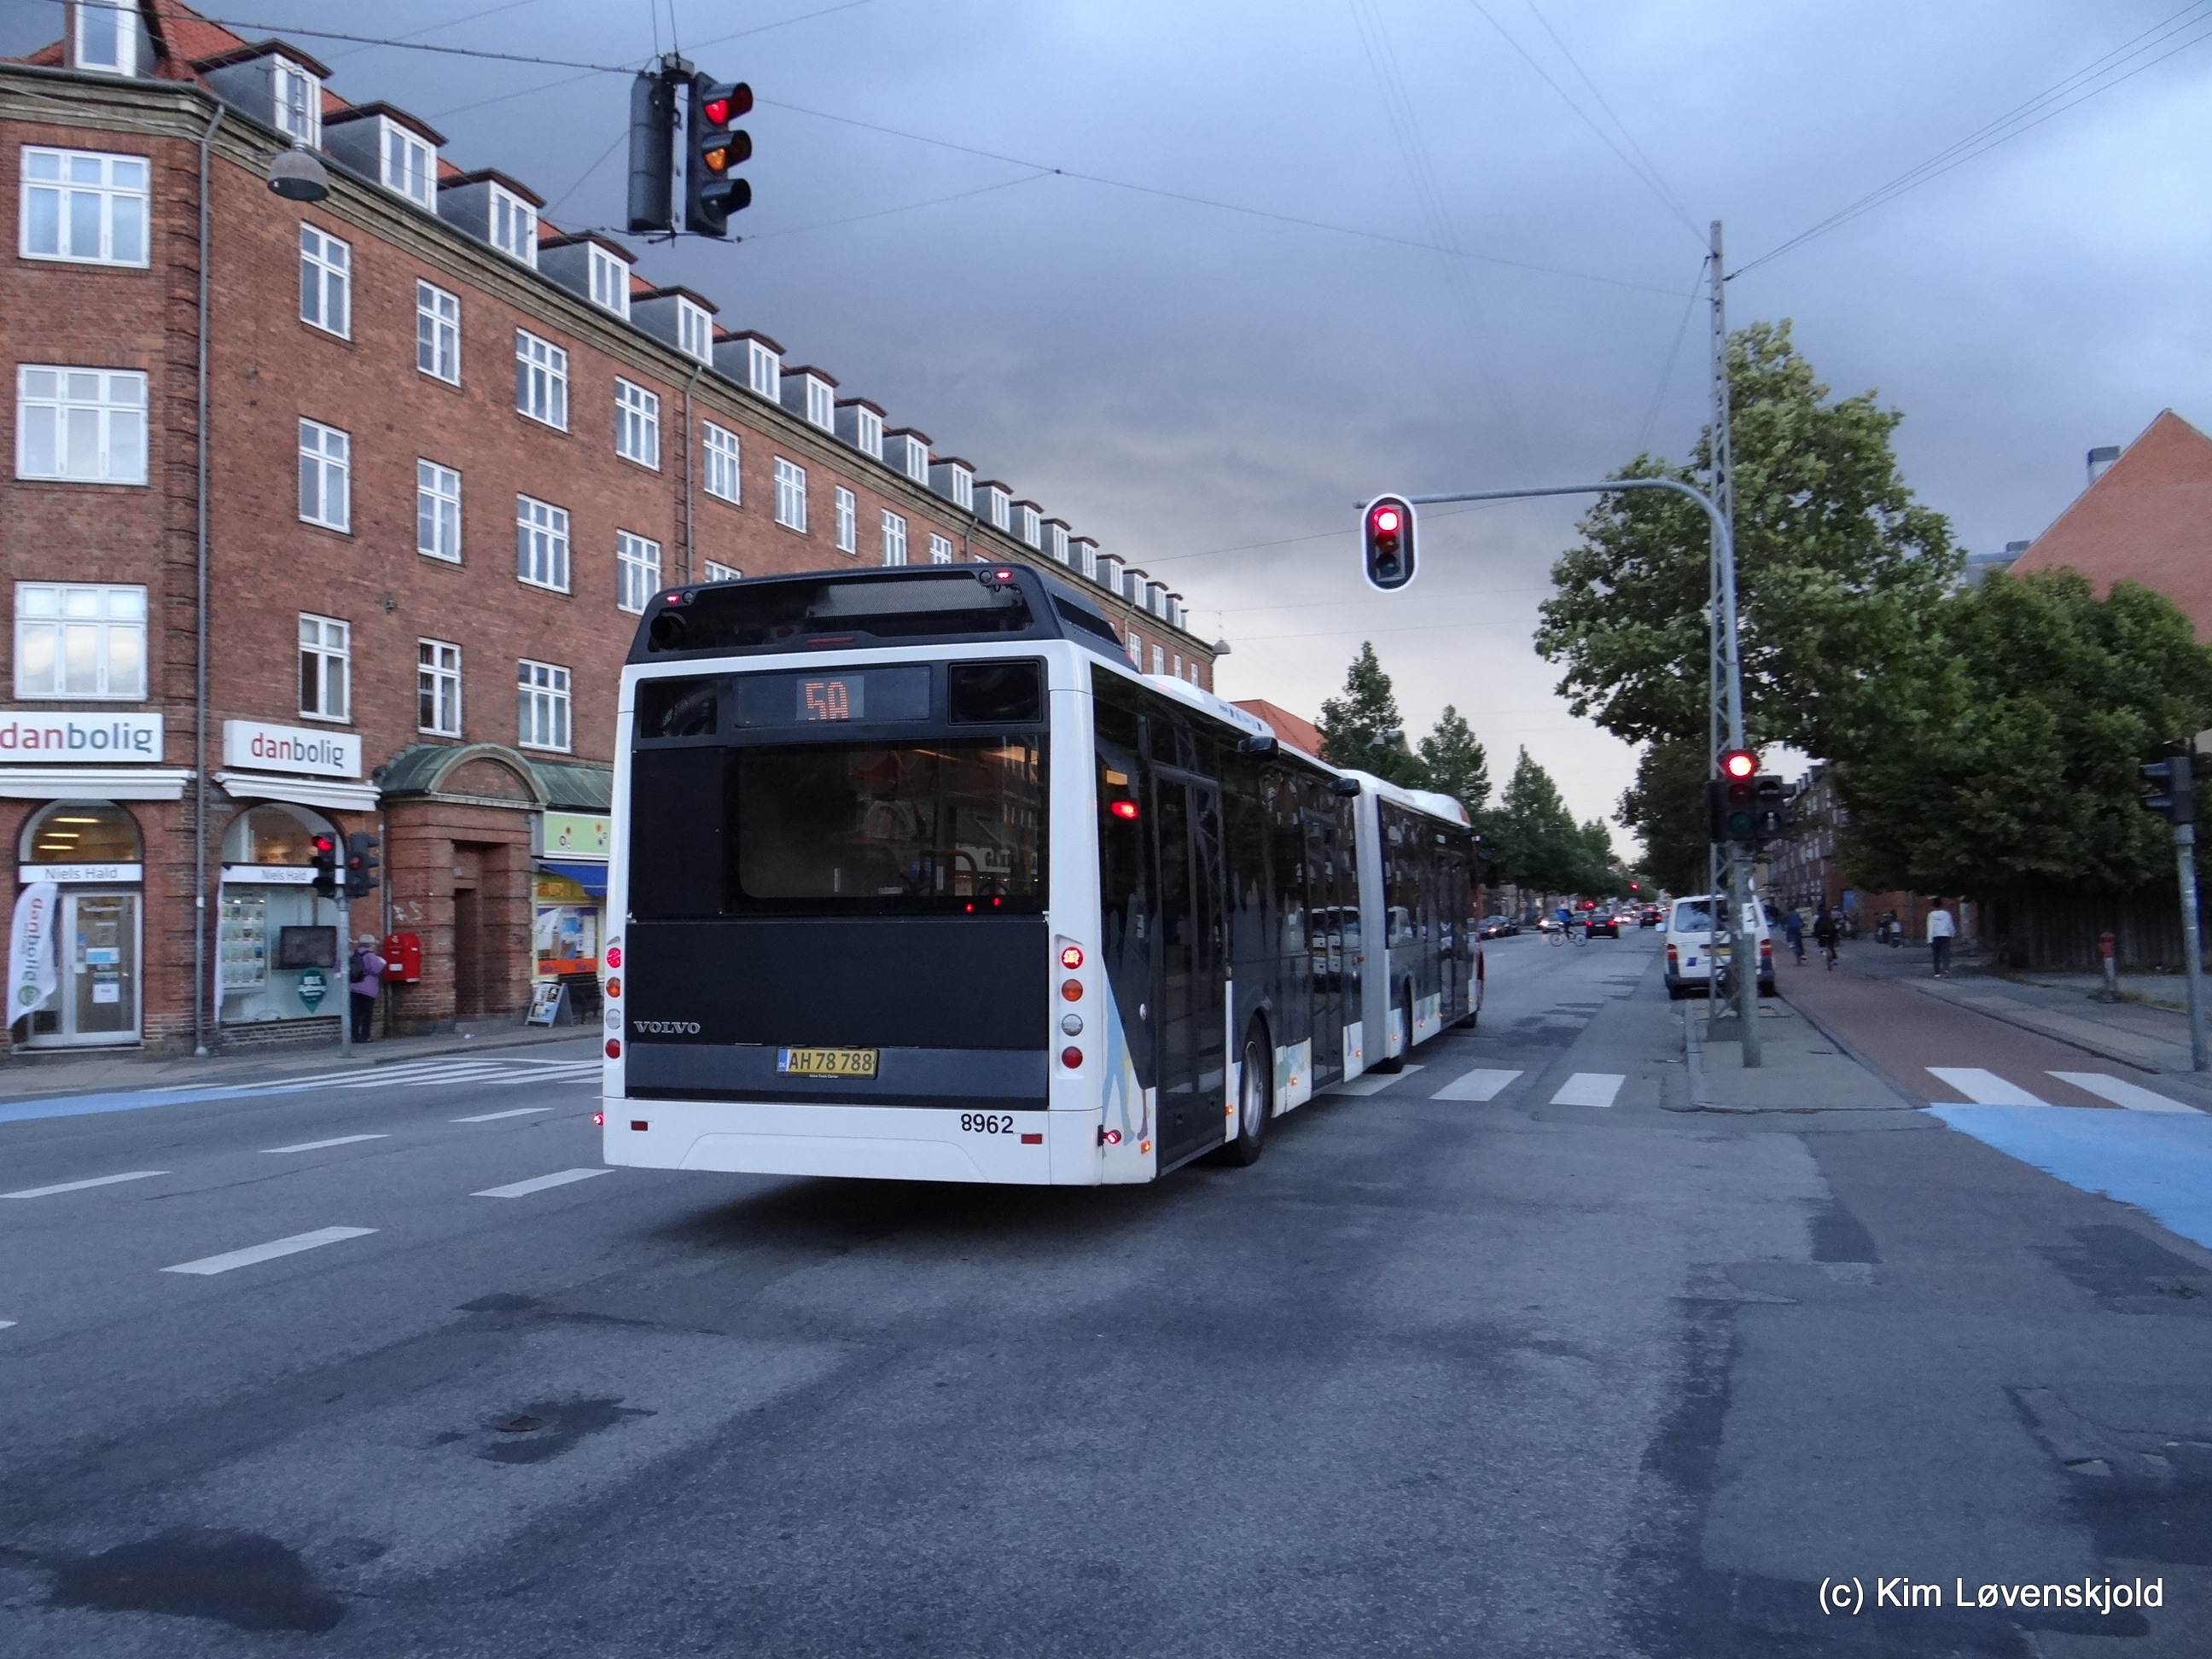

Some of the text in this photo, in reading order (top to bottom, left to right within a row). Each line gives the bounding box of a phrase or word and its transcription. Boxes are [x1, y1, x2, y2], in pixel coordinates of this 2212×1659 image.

[806, 682, 848, 720] 5A
[0, 722, 153, 754] danbolig
[251, 732, 345, 769] danbolig
[44, 867, 118, 879] Niels Hald
[261, 869, 285, 881] Niels
[21, 897, 44, 981] danbolig
[633, 1021, 701, 1034] VOLVO
[789, 1052, 872, 1071] AH 78 788
[960, 1113, 1014, 1134] 8962
